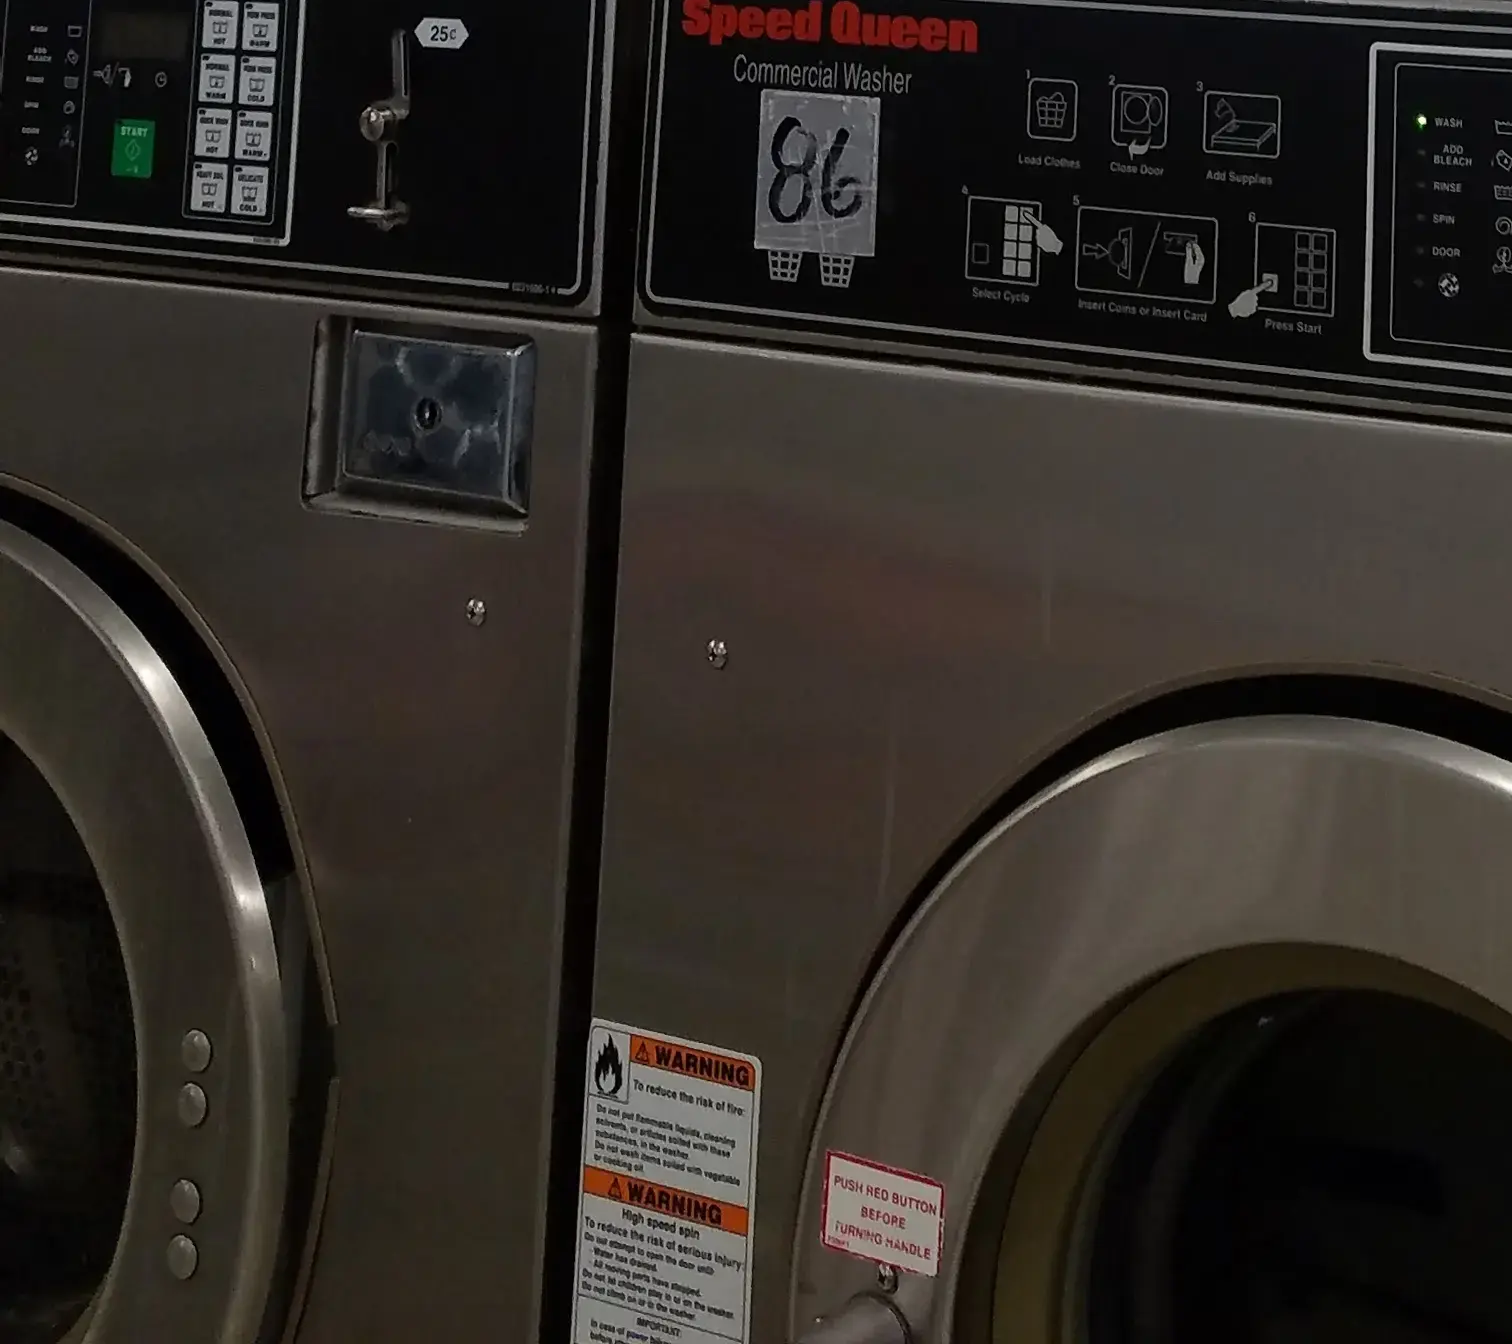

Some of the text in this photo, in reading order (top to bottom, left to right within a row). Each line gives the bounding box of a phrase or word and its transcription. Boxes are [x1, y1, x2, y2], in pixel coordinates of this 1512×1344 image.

[830, 0, 978, 52] Queen
[734, 54, 912, 94] Commercial Washer
[1434, 118, 1463, 128] WASH
[1443, 144, 1463, 155] ADD
[1018, 153, 1081, 169] Load Clothes
[1110, 162, 1164, 177] Close Door
[1434, 156, 1472, 167] BLEACH
[769, 116, 863, 224] 86
[1206, 169, 1273, 186] Add Supplies
[1433, 182, 1462, 193] RINSE
[1433, 214, 1455, 225] SPIN
[1432, 247, 1460, 257] DOOR
[972, 287, 1030, 304] Select Cycle
[1265, 318, 1323, 335] Press Start
[654, 1045, 750, 1087] WARNING
[627, 1180, 722, 1225] WARNING
[833, 1175, 937, 1216] PUSH RED BUTTON
[622, 1208, 700, 1240] High speed spin
[861, 1207, 906, 1229] BEFORE
[835, 1221, 882, 1245] TURNING
[885, 1238, 931, 1260] HANDLE
